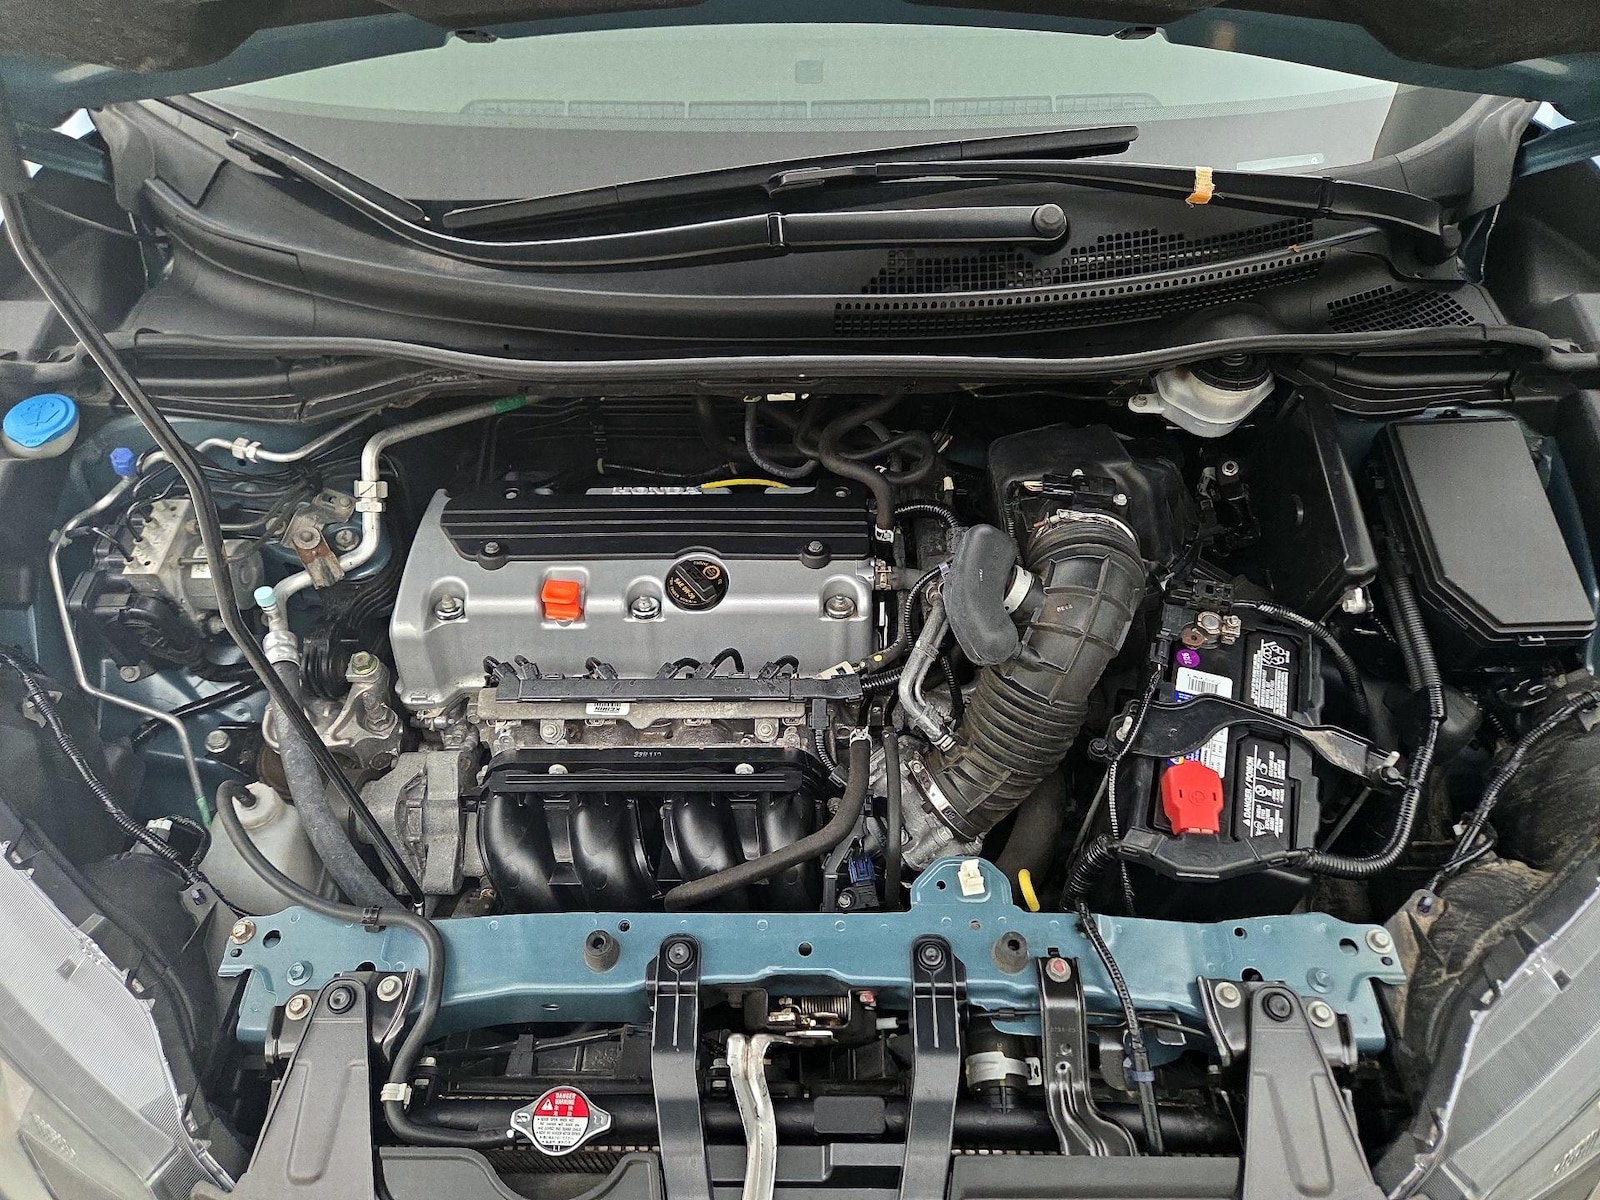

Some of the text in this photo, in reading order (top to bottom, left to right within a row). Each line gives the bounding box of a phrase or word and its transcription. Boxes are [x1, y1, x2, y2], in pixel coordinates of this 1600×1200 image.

[611, 486, 702, 496] HONDA
[1245, 755, 1254, 783] POISON
[1243, 788, 1252, 819] DANGER
